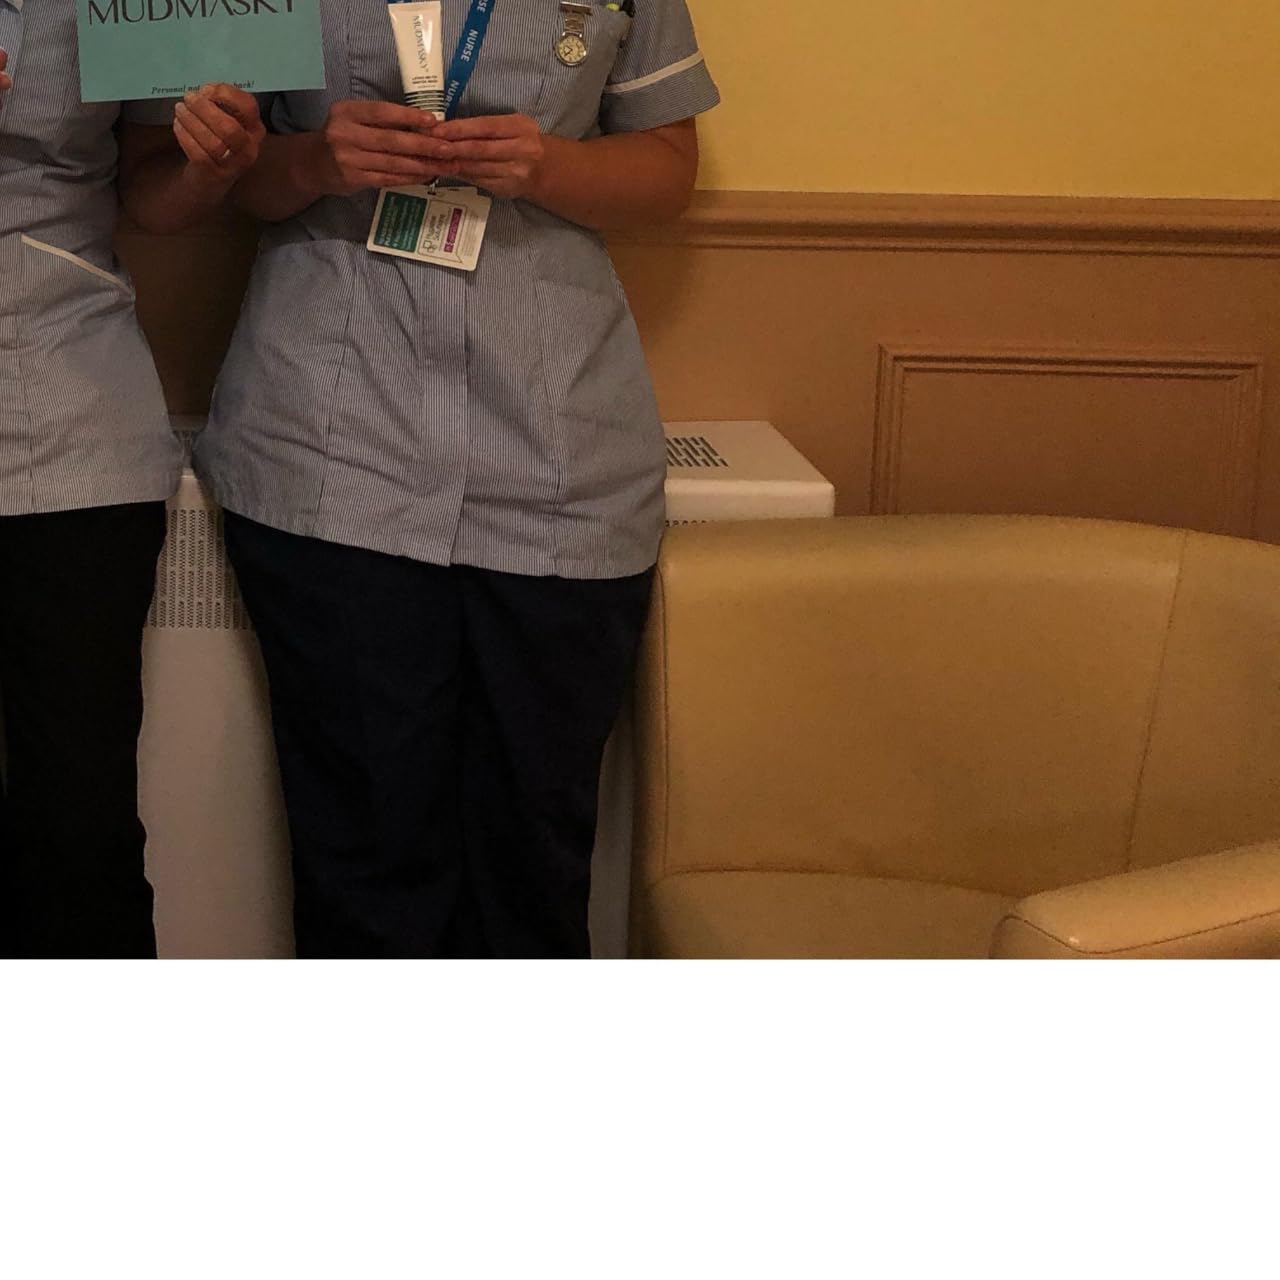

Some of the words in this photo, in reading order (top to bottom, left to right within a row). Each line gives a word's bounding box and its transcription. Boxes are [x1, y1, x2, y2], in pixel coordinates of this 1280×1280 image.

[460, 29, 479, 63] NURSE
[151, 84, 186, 95] Personal
[187, 84, 201, 93] not
